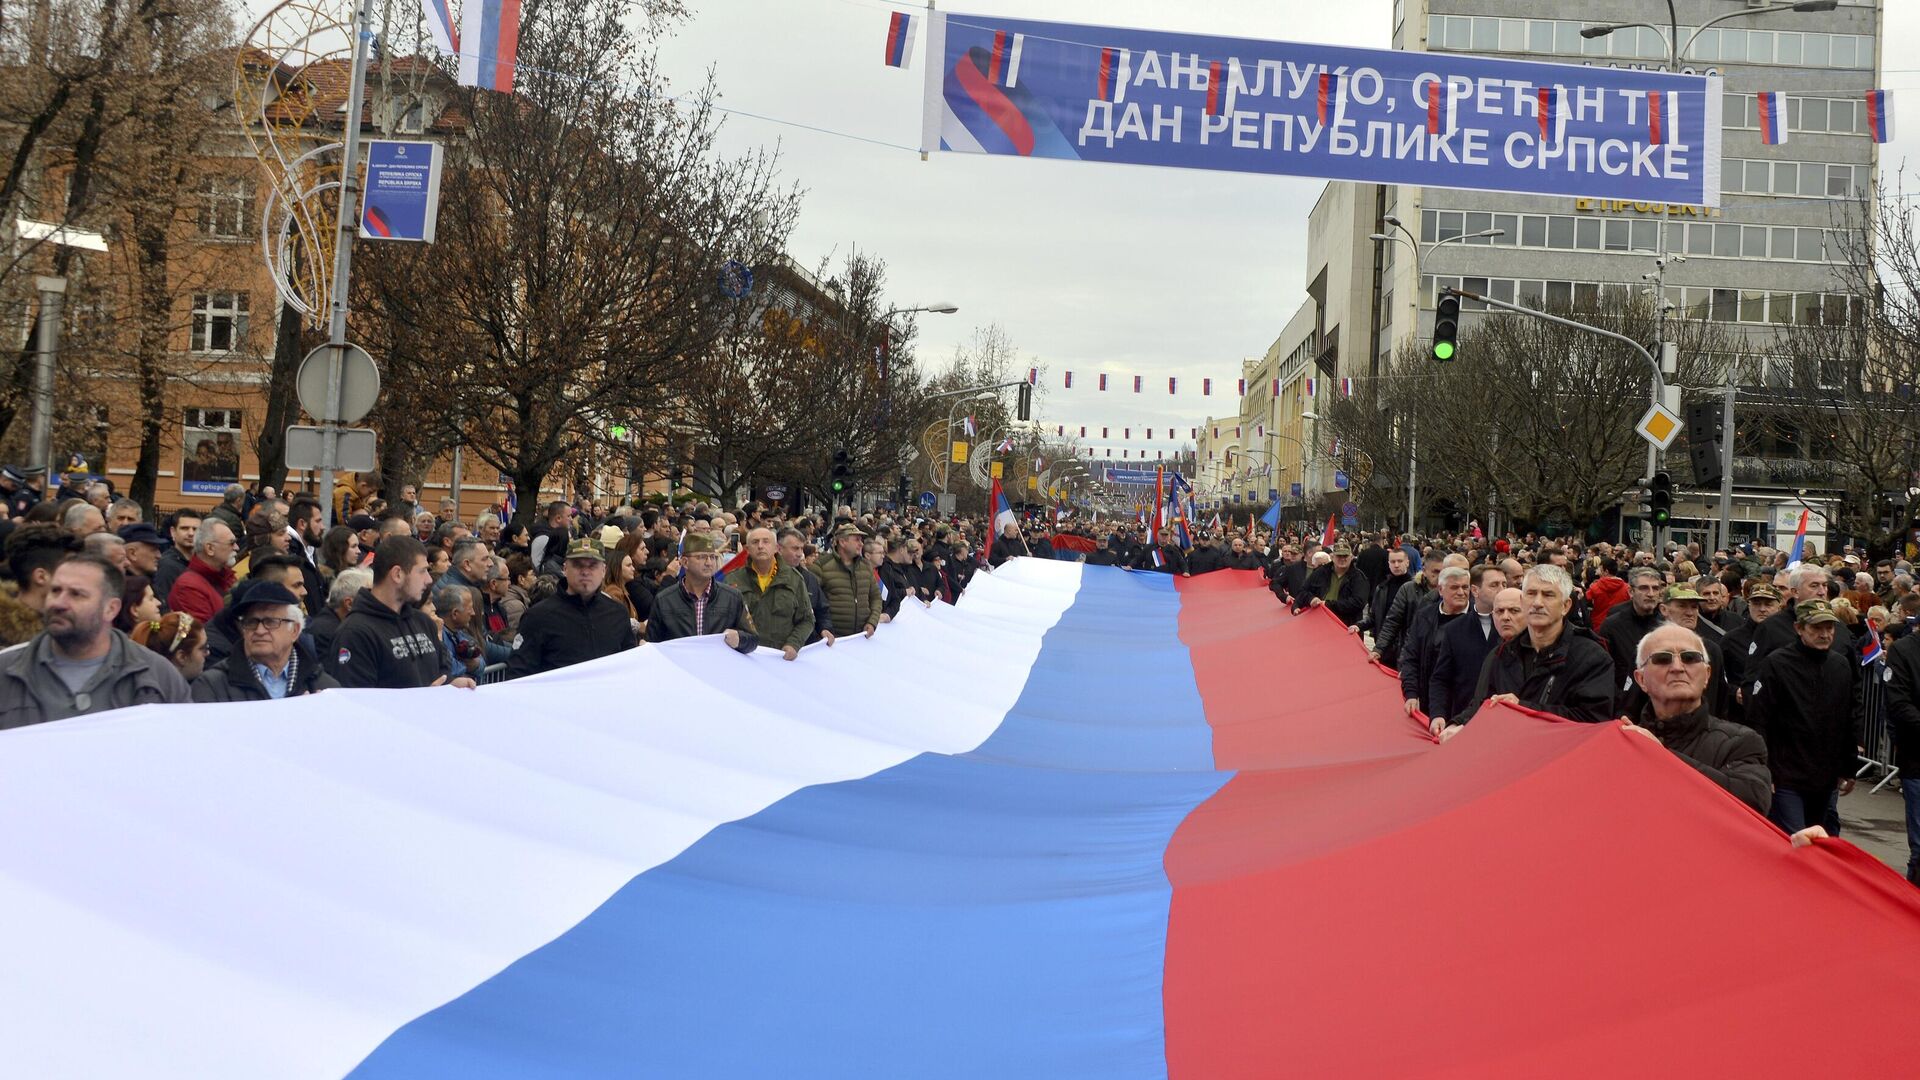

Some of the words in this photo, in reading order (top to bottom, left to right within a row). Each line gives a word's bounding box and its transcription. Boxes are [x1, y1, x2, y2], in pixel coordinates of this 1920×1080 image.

[1619, 89, 1678, 127] Т
[1078, 99, 1183, 148] ДАН
[1200, 108, 1489, 166] РЕПУБЛИКЕ
[1503, 131, 1689, 180] СРПСКЕ
